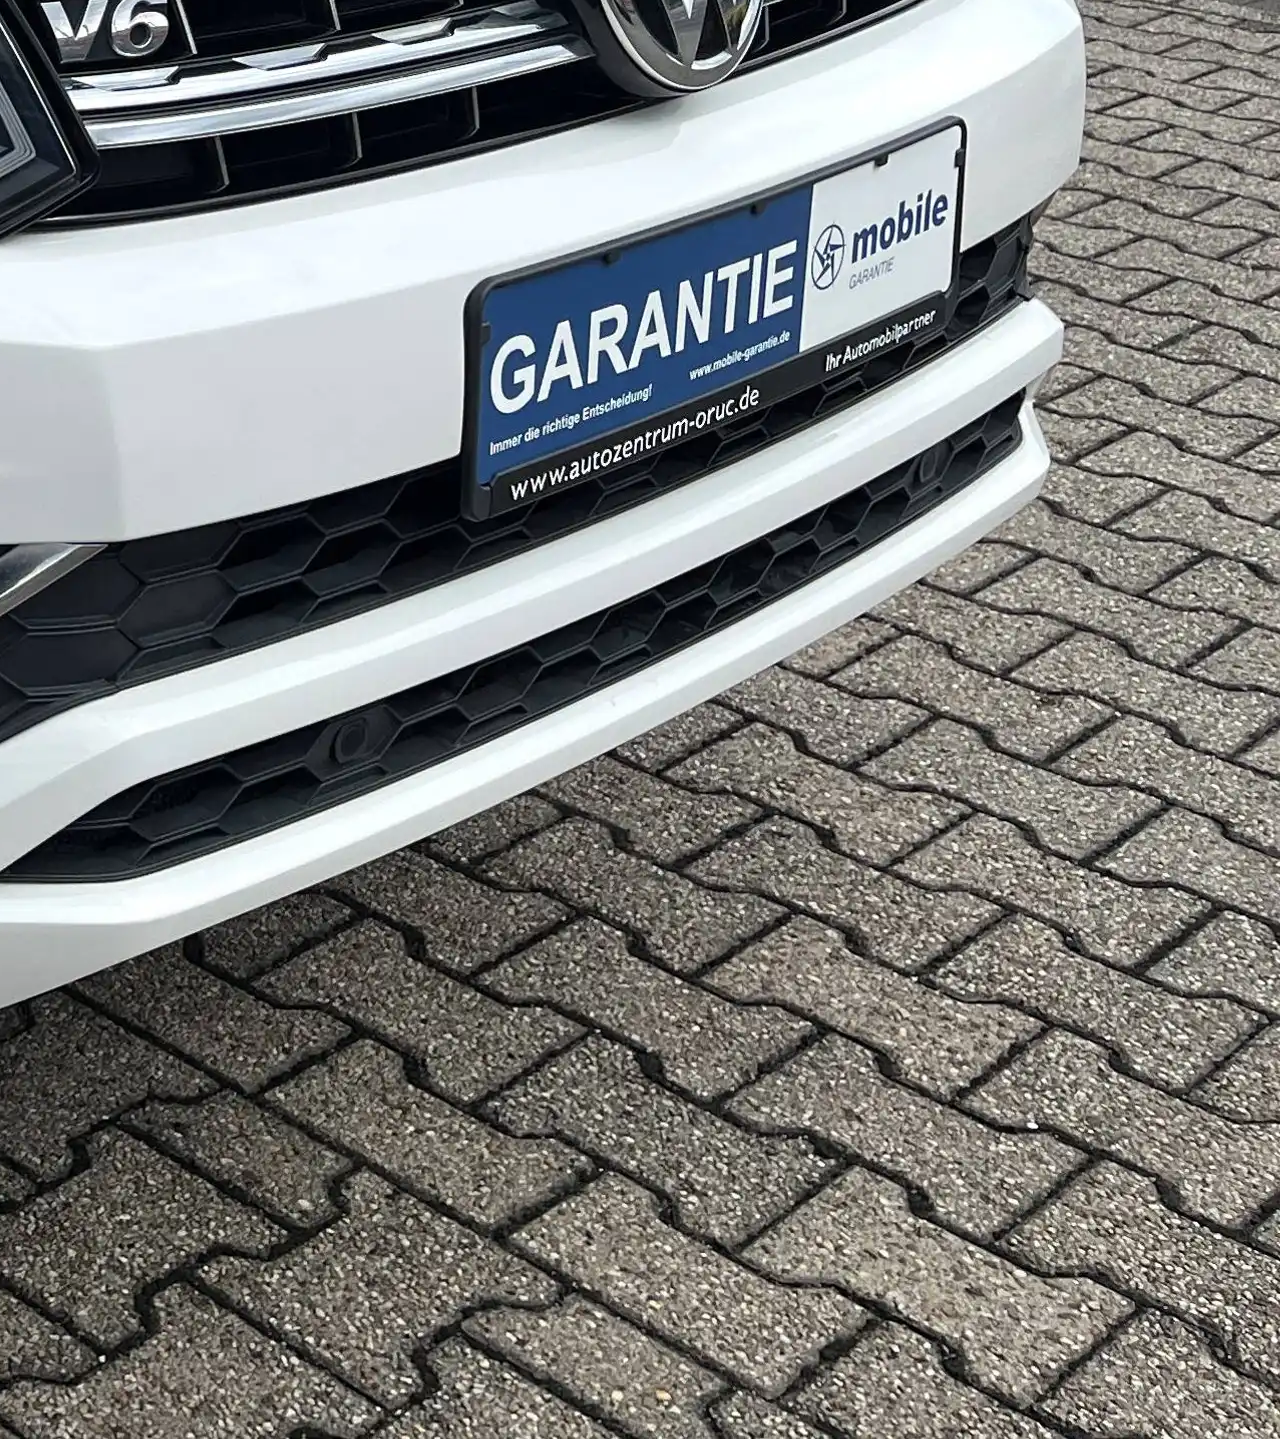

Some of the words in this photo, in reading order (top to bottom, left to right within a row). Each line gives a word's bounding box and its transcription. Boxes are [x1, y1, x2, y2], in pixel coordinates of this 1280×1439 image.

[851, 189, 949, 264] mobile
[848, 257, 896, 290] GARANTIE
[490, 239, 798, 415] GARANTIE
[689, 329, 791, 380] www.mobile-garantie.de
[825, 352, 842, 372] Ihr
[842, 310, 937, 365] Automobilpartner
[489, 432, 524, 456] Immer
[524, 426, 541, 441] die
[541, 412, 581, 436] richtige
[581, 382, 654, 422] Entscheidung!
[510, 385, 760, 502] www.autozentrum-oruc.de
